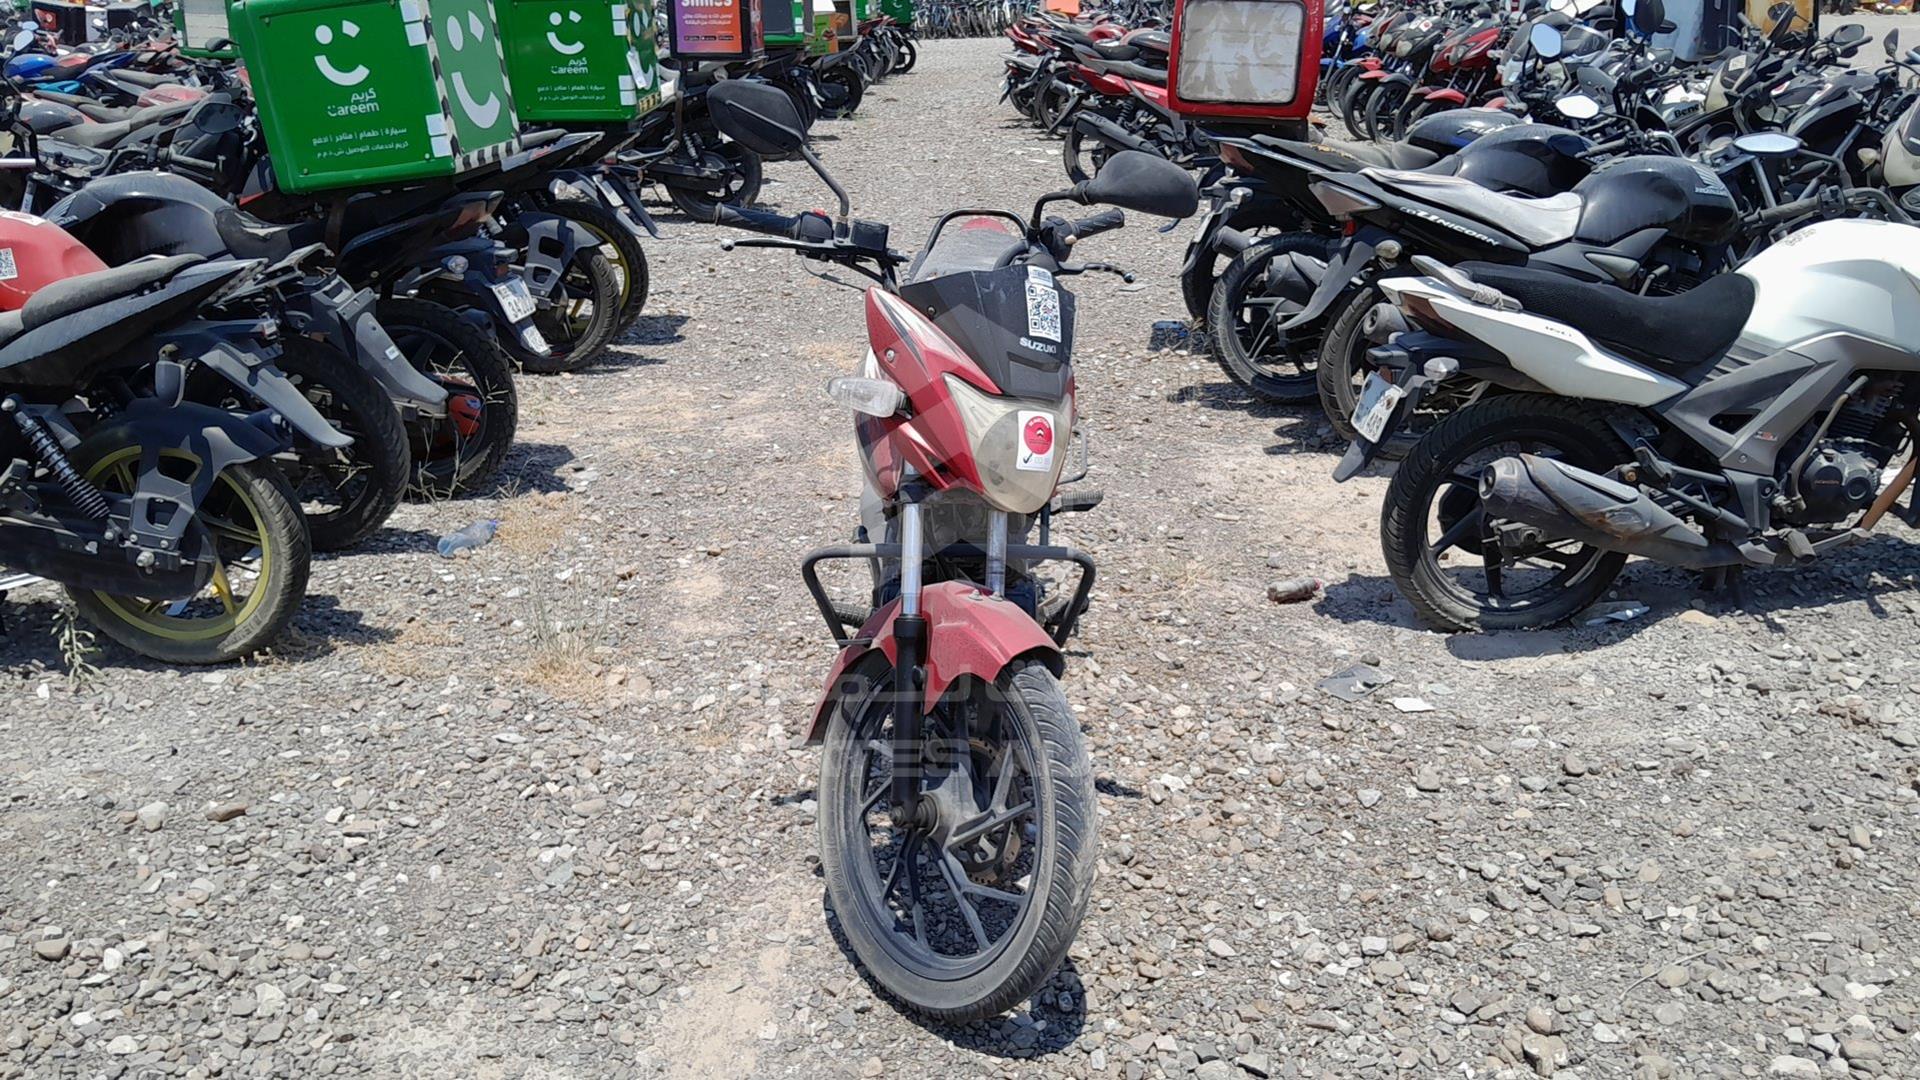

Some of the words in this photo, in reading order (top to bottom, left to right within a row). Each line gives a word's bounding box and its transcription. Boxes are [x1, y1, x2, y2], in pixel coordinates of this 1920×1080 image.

[351, 87, 377, 103] كريم
[327, 102, 380, 117] Careem
[1019, 336, 1058, 354] SUZUKI
